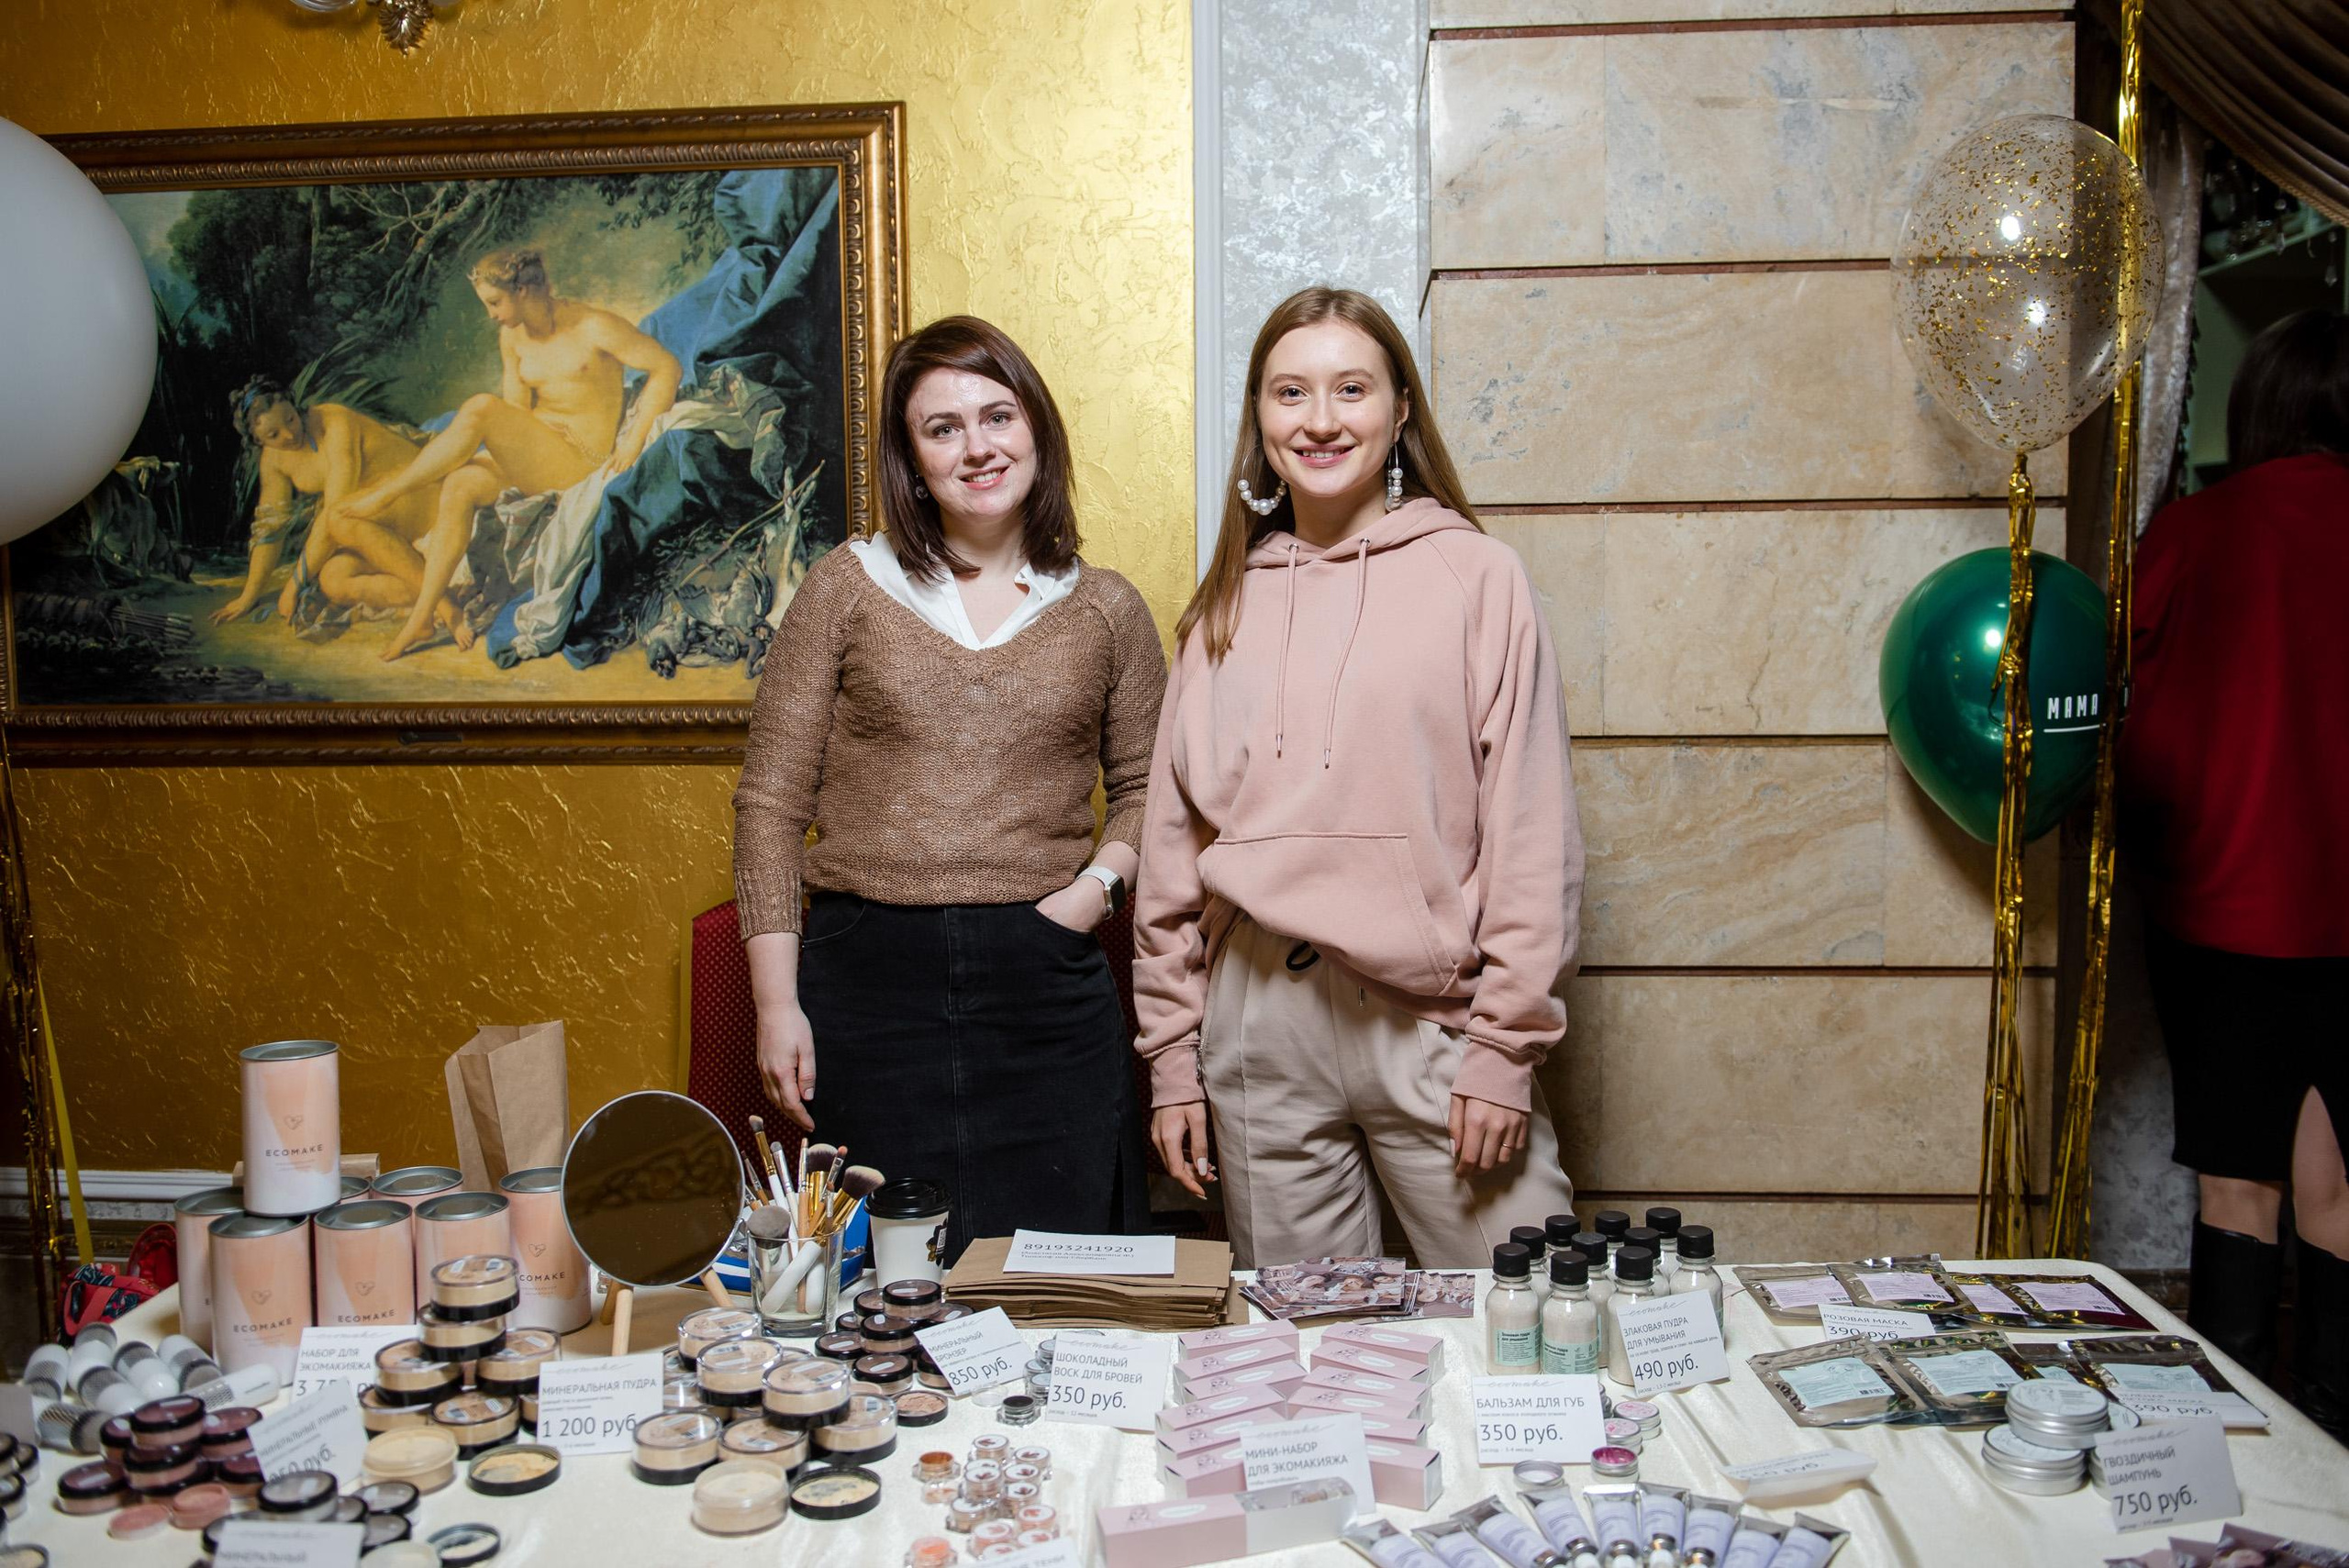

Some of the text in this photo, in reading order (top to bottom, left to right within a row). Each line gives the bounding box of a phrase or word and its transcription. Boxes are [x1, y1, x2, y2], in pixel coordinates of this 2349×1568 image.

[265, 1143, 323, 1157] ECOMAKE
[1023, 1243, 1134, 1252] 89193241920
[519, 1272, 565, 1282] COMAKE
[338, 1309, 395, 1323] ECOMAKE
[1823, 1313, 1871, 1324] РОЗОВАЯ
[1872, 1318, 1909, 1327] МАСКА
[233, 1318, 293, 1332] ECOMAKE
[1623, 1317, 1689, 1338] ЗЛАКОВАЯ ПУДРА
[1828, 1326, 1861, 1337] 390
[928, 1330, 983, 1352] МИНЕРАЛЬНЫЙ
[1627, 1329, 1687, 1351] ДЛЯ УМЫВАНИЯ
[301, 1348, 360, 1358] НАБОР ДЛЯ
[935, 1347, 967, 1362] БРОНЗЕР
[1056, 1352, 1128, 1368] ШОКОЛАДНЫЙ
[299, 1362, 371, 1372] ЭКОМАКИЯЖА
[948, 1356, 1012, 1385] 850 руб.
[1053, 1366, 1142, 1385] ВОСК ДЛЯ БРОВЕЙ
[1635, 1353, 1698, 1381] 490 руб.
[295, 1379, 307, 1396] 3
[542, 1378, 658, 1396] МИНЕРАЛЬНАЯ ПУДРА
[1052, 1385, 1127, 1411] 350 руб.
[1476, 1396, 1585, 1409] БАЛЬЗАМ ДЛЯ ГУБ
[2132, 1404, 2170, 1413] 390
[542, 1419, 551, 1438] 1
[559, 1417, 596, 1437] 200
[1480, 1423, 1563, 1444] 350 руб.
[1245, 1441, 1318, 1461] МИНИ-НАБОР
[2104, 1445, 2176, 1468] ГВОЗДИЧНЫЙ
[1247, 1454, 1349, 1478] ДЛЯ ЭКОМАКИЯЖА
[2108, 1469, 2162, 1485] ШАМПУНЬ
[2113, 1485, 2198, 1516] 750 руб.
